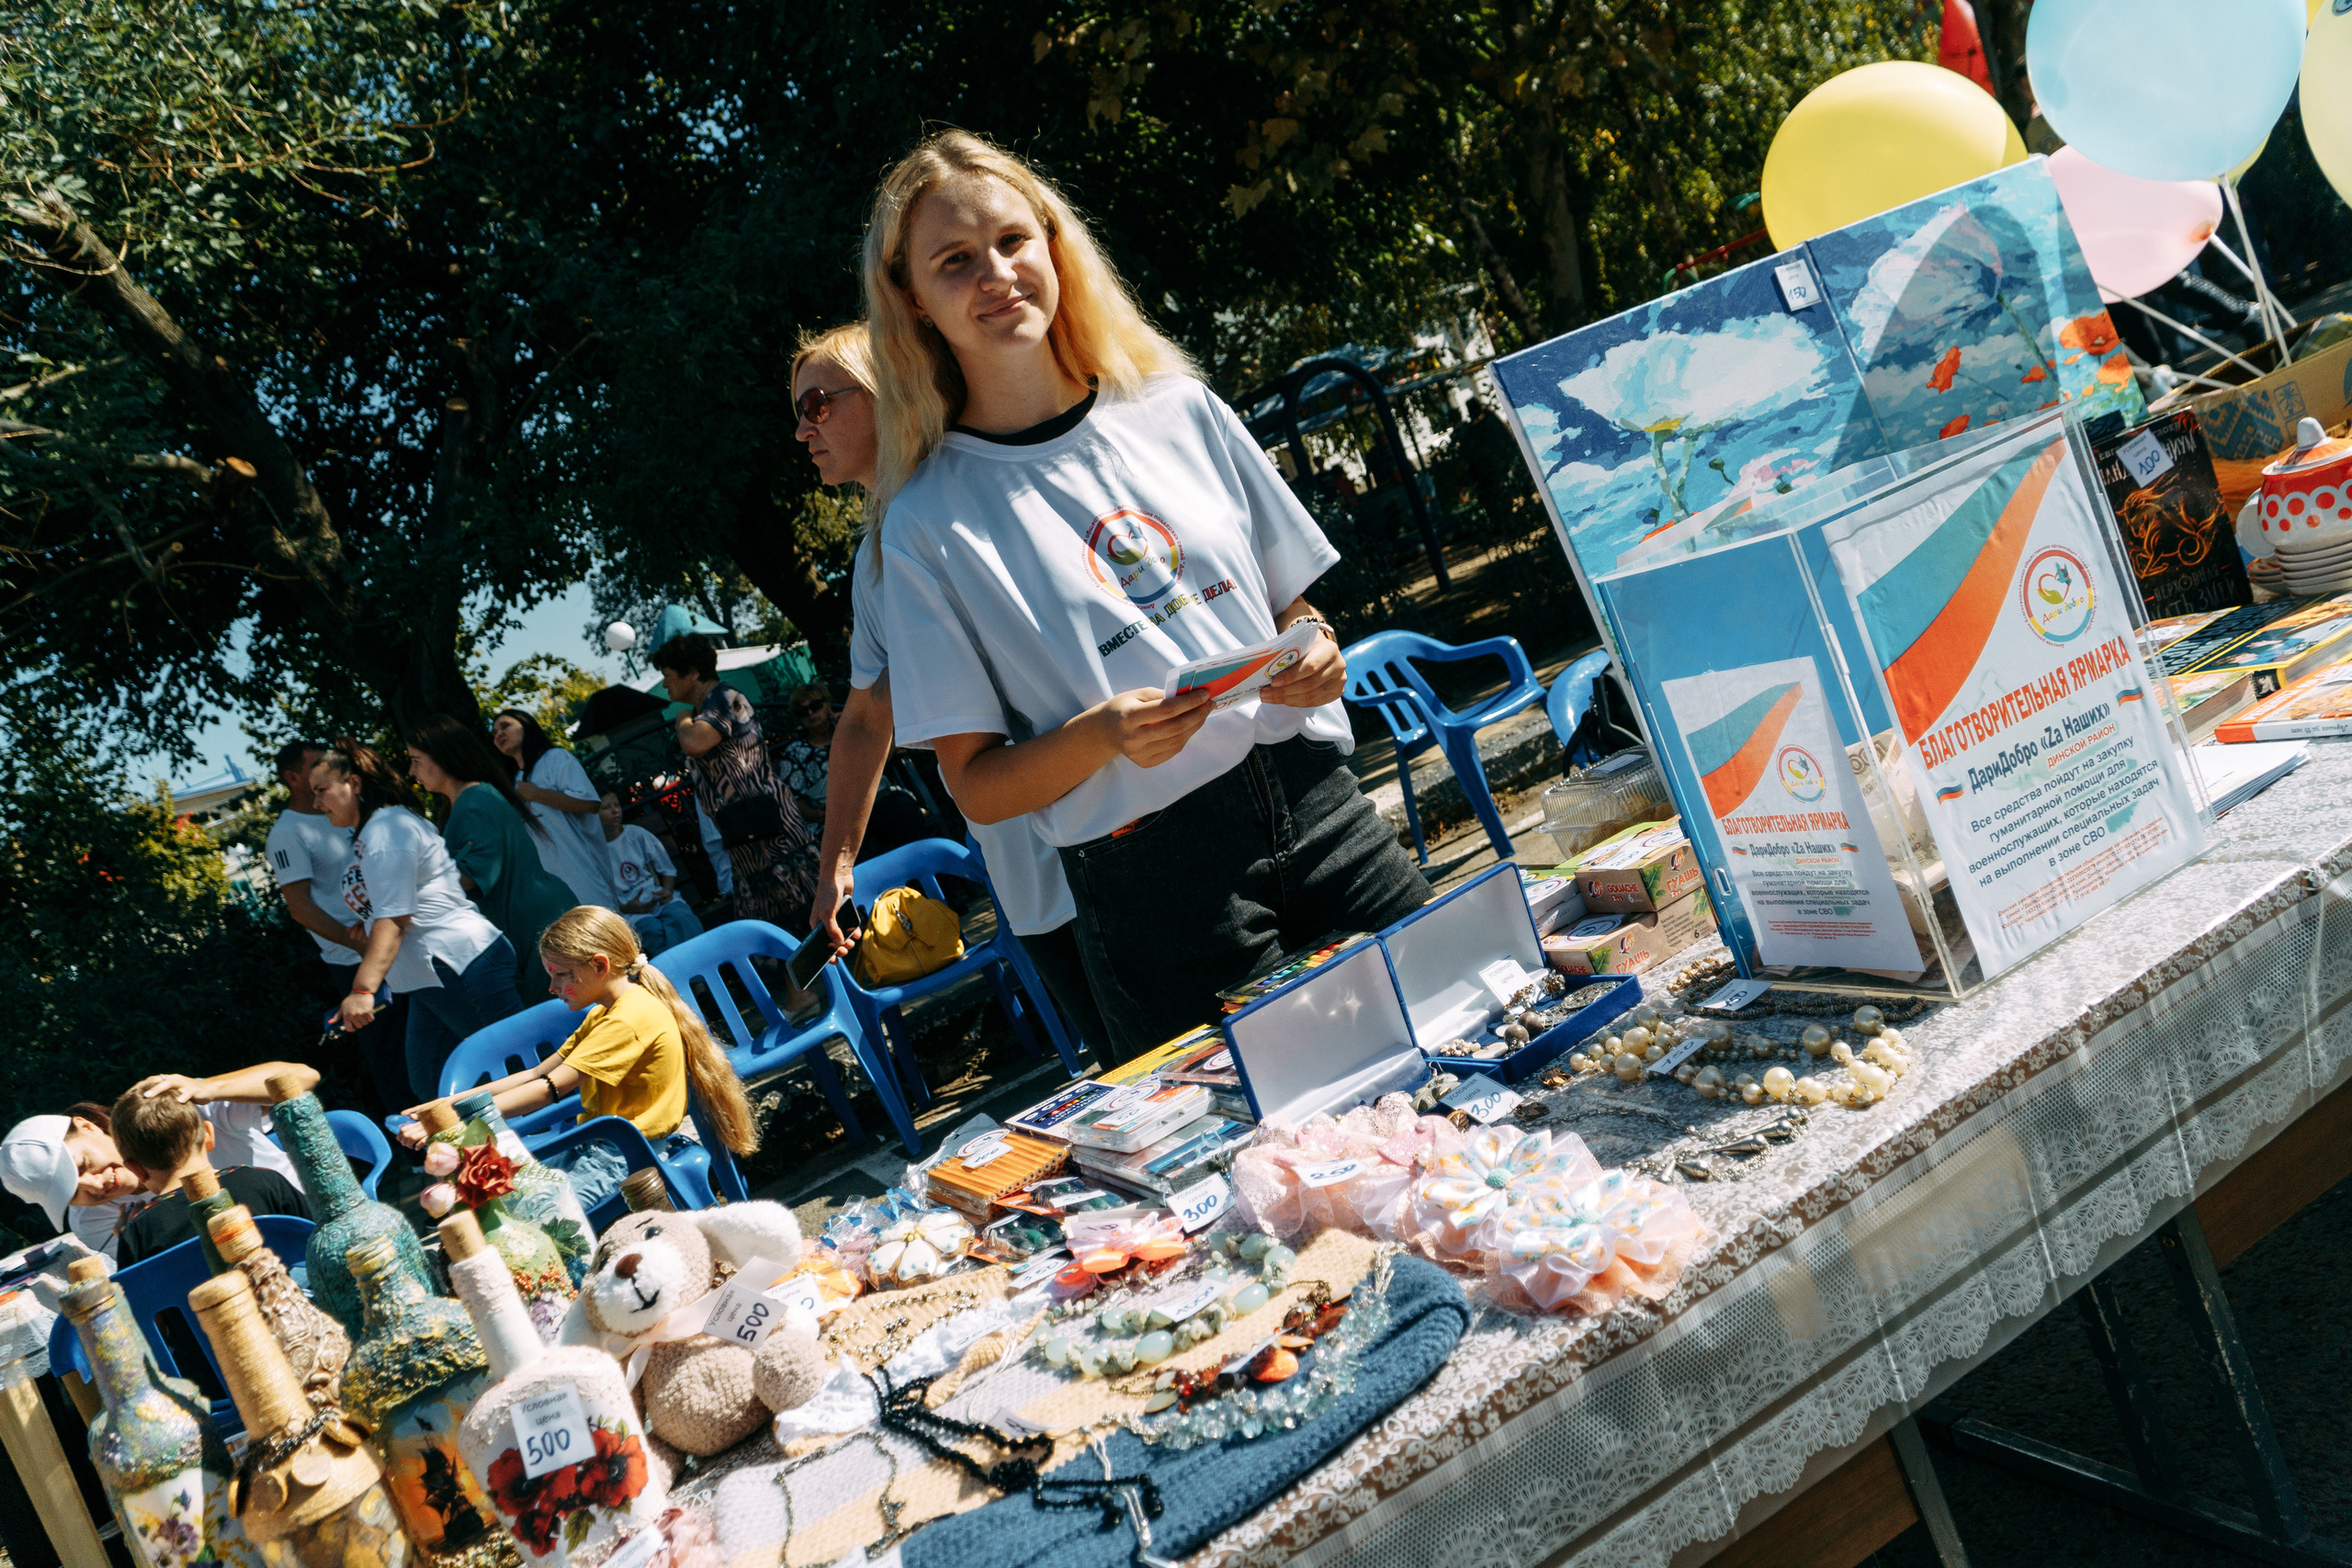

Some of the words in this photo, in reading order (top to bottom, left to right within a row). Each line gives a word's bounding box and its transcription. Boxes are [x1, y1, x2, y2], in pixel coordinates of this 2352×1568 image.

[2137, 449, 2161, 476] 100
[1120, 565, 1146, 590] Дари
[1098, 620, 1148, 657] ВМЕСТЕ
[1146, 613, 1166, 626] НА
[1202, 578, 1238, 603] ДЕЛА!
[2042, 608, 2063, 625] Дари
[2064, 596, 2085, 611] добро
[1918, 666, 2070, 771] БЛАГОТВОРИТЕЛЬНАЯ
[2067, 636, 2132, 691] ЯРМАРКА
[1967, 741, 2039, 795] ДариДобро
[2063, 702, 2110, 739] Наших»
[2047, 737, 2088, 769] ДИНСКОЙ
[2086, 723, 2116, 748] РАЙОН
[1970, 815, 1993, 833] Все
[1994, 788, 2042, 821] средства
[2043, 766, 2081, 793] пойдут
[2082, 757, 2096, 771] на
[2097, 736, 2135, 764] закупку
[1989, 793, 2063, 843] гуманитарной
[2064, 771, 2105, 800] помощи
[2107, 759, 2126, 775] для
[1721, 813, 1808, 836] БЛАГОТВОРИТЕЛЬНАЯ
[1807, 811, 1851, 831] ЯРМАРКА
[1968, 817, 2063, 874] военнослужащих,
[2063, 789, 2107, 820] которые
[2108, 760, 2159, 795] находятся
[1979, 874, 1993, 887] на
[1994, 833, 2062, 879] выполнении
[2062, 795, 2131, 840] специальных
[2132, 777, 2160, 801] задач
[1749, 842, 1790, 858] ДариДобро
[1804, 841, 1837, 854] Наших»
[2048, 856, 2057, 867] в
[2057, 845, 2082, 863] зоне
[2082, 826, 2106, 847] СВО
[1821, 856, 1840, 864] РАЙОН
[1666, 867, 1700, 891] ГУАШЬ
[1752, 869, 1764, 877] Все
[1765, 869, 1792, 879] средства
[1793, 868, 1816, 877] пойдут
[1827, 869, 1853, 878] закупку
[1762, 878, 1805, 888] гуманитарной
[1806, 879, 1833, 887] помощи
[1834, 878, 1848, 886] для
[1606, 884, 1639, 894] GOUACHE
[1628, 894, 1634, 903] 6
[1751, 888, 1806, 897] военнослужащих,
[1806, 889, 1834, 897] которые
[1834, 889, 1870, 897] находятся
[1805, 898, 1850, 908] специальных
[1851, 898, 1871, 907] задач
[1694, 929, 1700, 939] 6
[1487, 960, 1512, 978] Условная
[1616, 950, 1650, 975] ГУАШЬ
[1500, 973, 1515, 985] цена
[1447, 1078, 1478, 1101] Условная
[1464, 1088, 1481, 1101] цена
[1470, 1091, 1502, 1119] 300
[1174, 1179, 1214, 1201] Условная
[1188, 1190, 1209, 1203] цена
[1182, 1194, 1218, 1223] 300
[770, 1277, 806, 1294] Условная
[708, 1290, 735, 1326] Условная
[727, 1303, 742, 1322] цена
[736, 1303, 770, 1342] 500
[520, 1392, 569, 1414] Условная
[535, 1413, 561, 1426] цена
[526, 1428, 571, 1466] 500
[609, 1535, 650, 1568] словная
